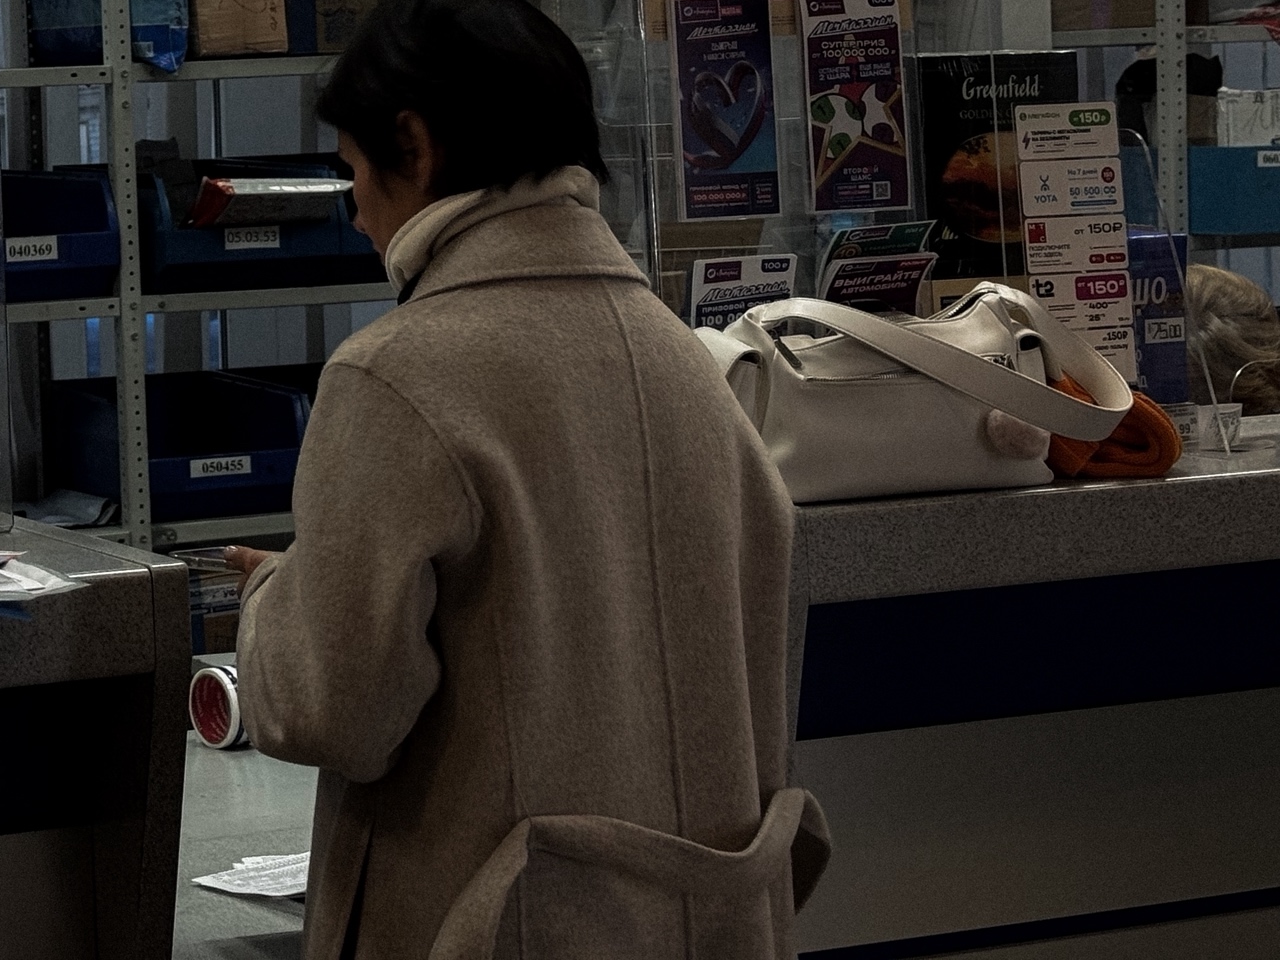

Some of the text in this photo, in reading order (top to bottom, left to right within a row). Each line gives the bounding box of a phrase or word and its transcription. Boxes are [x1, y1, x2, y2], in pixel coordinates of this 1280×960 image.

[821, 39, 886, 49] СУПЕРПРИЗ
[822, 49, 841, 58] 100
[844, 48, 866, 57] 000
[867, 47, 889, 56] 000
[962, 74, 1040, 100] Greenfield
[1034, 195, 1057, 203] YOTA
[226, 230, 278, 244] 05.03.53
[9, 242, 53, 258] 040369
[833, 270, 921, 288] ВЫИГРАЙТЕ
[702, 301, 745, 313] ПРИЗОВОЙ
[201, 458, 244, 474] 050455
